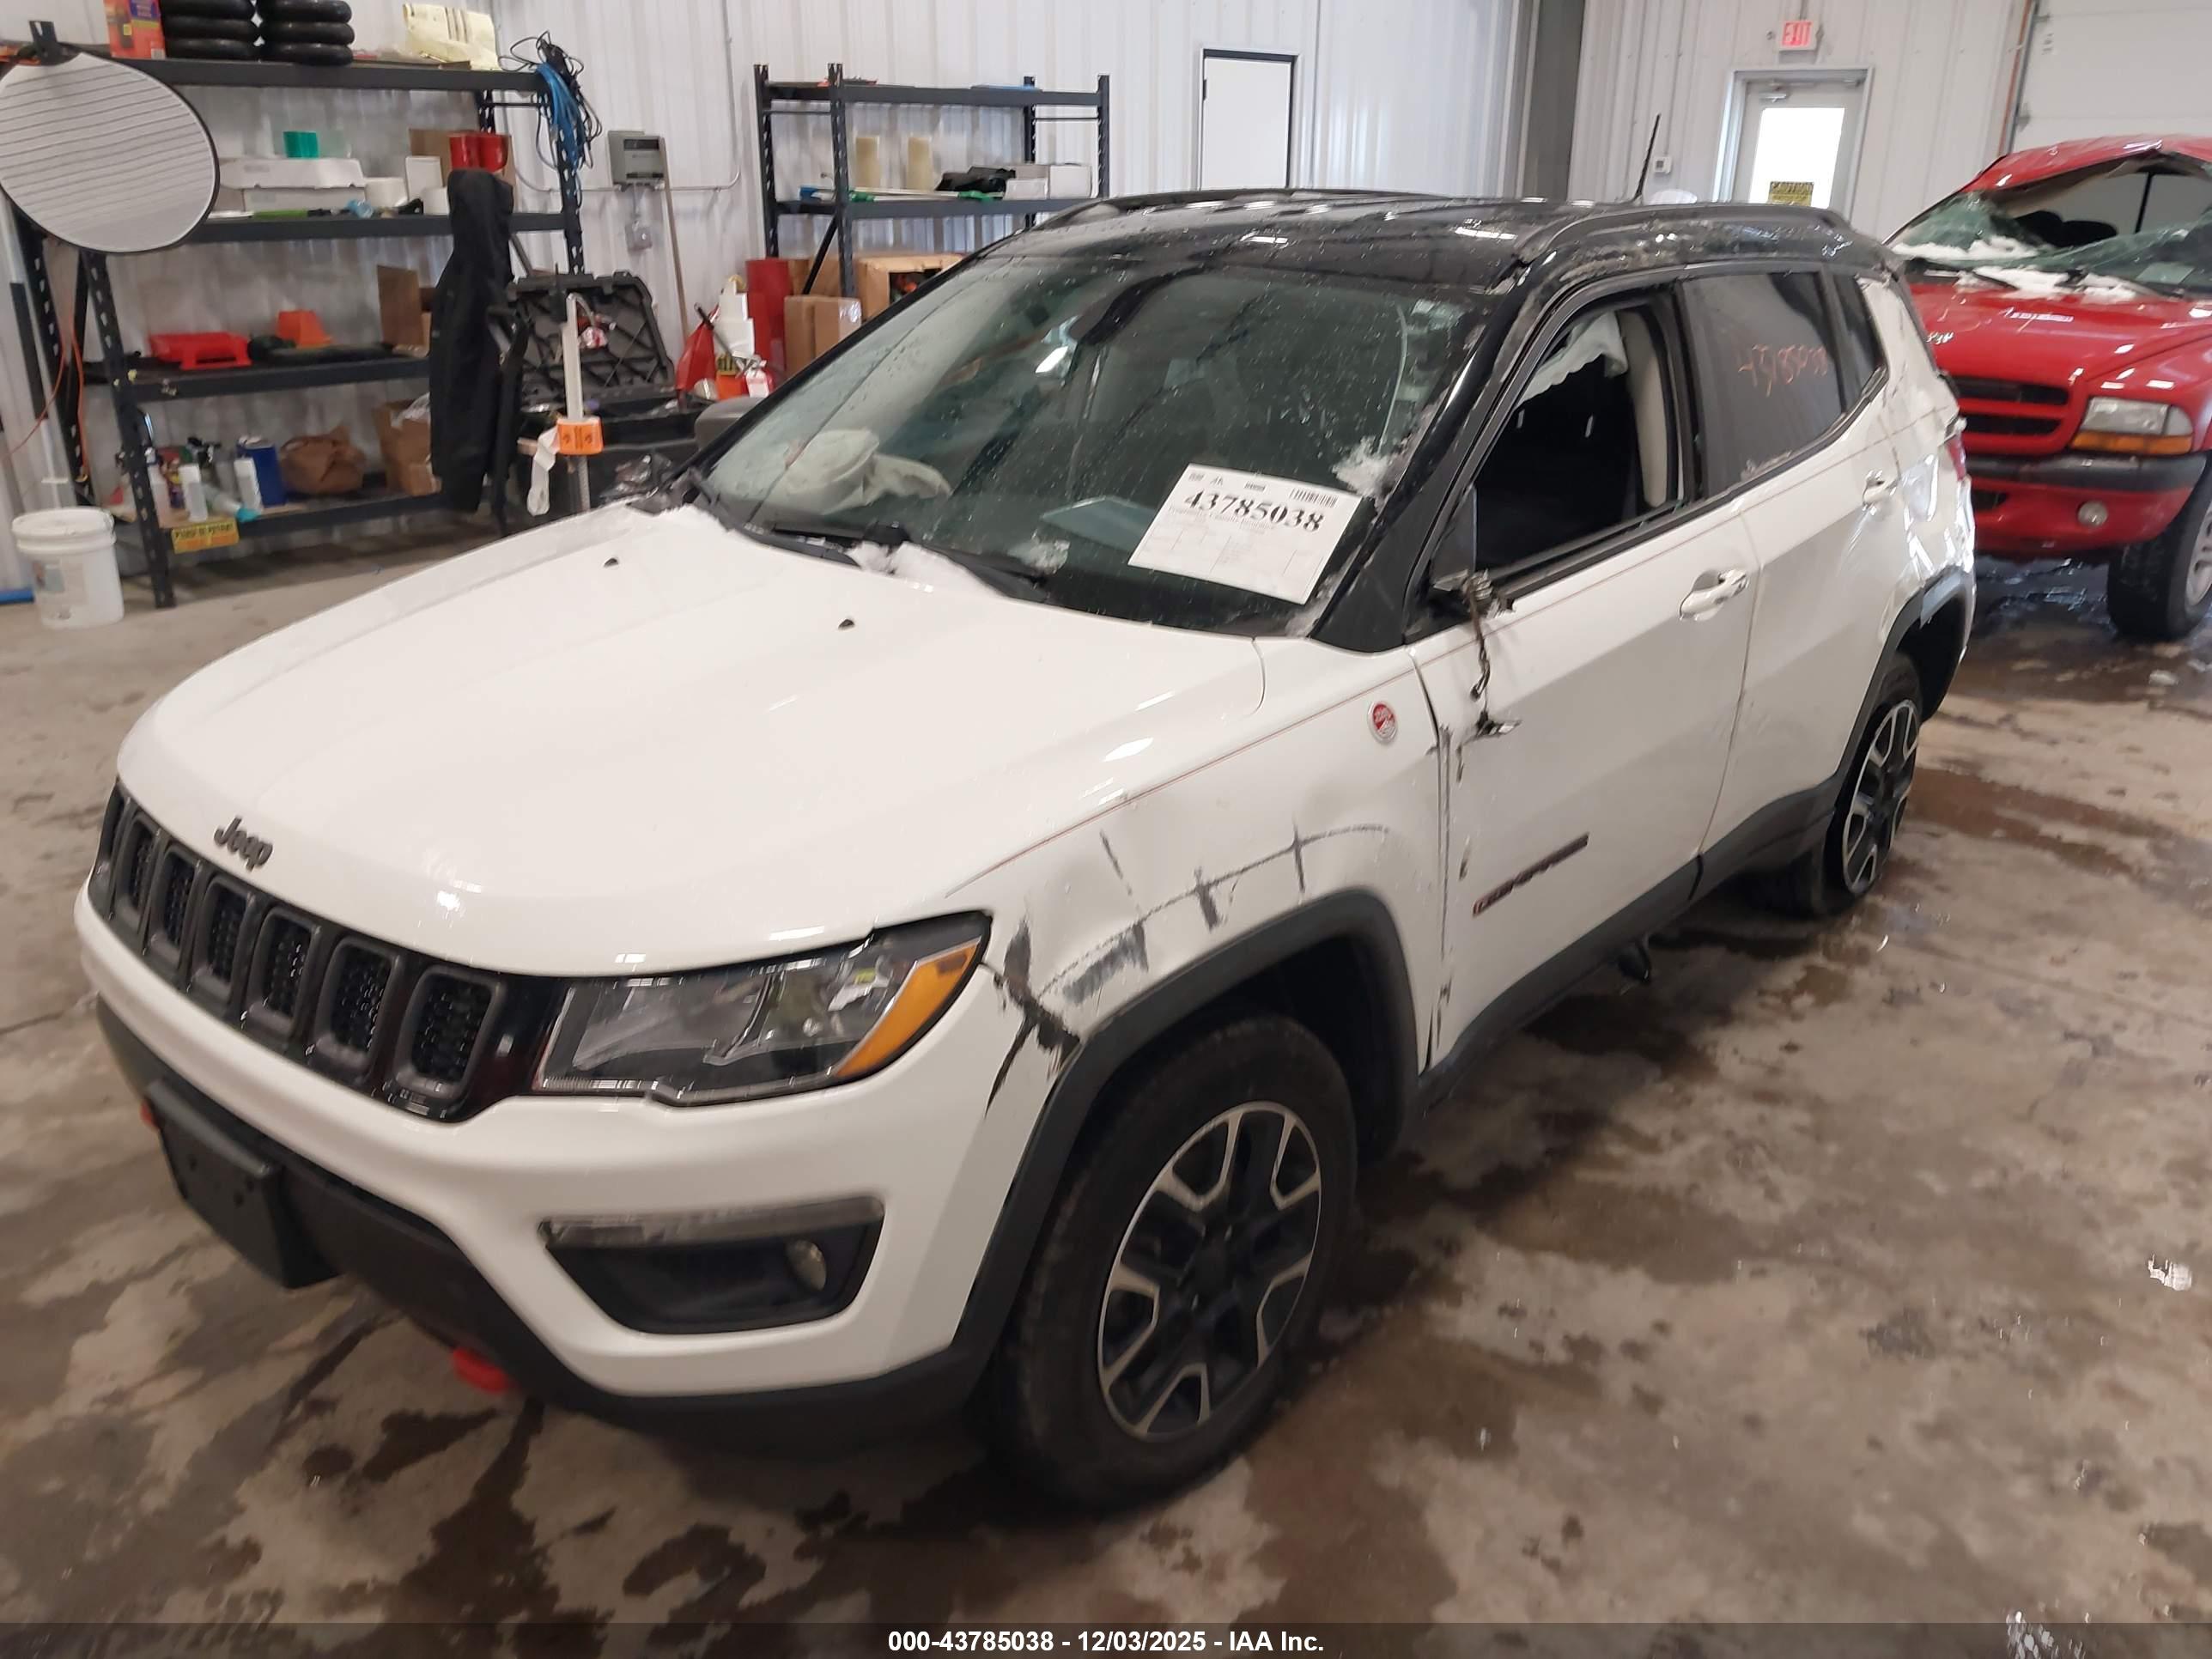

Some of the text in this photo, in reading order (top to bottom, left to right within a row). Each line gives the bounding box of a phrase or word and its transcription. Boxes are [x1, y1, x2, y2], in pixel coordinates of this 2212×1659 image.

[1782, 21, 1812, 46] EXIT
[1183, 488, 1324, 532] 43785038
[214, 816, 273, 872] Jeep
